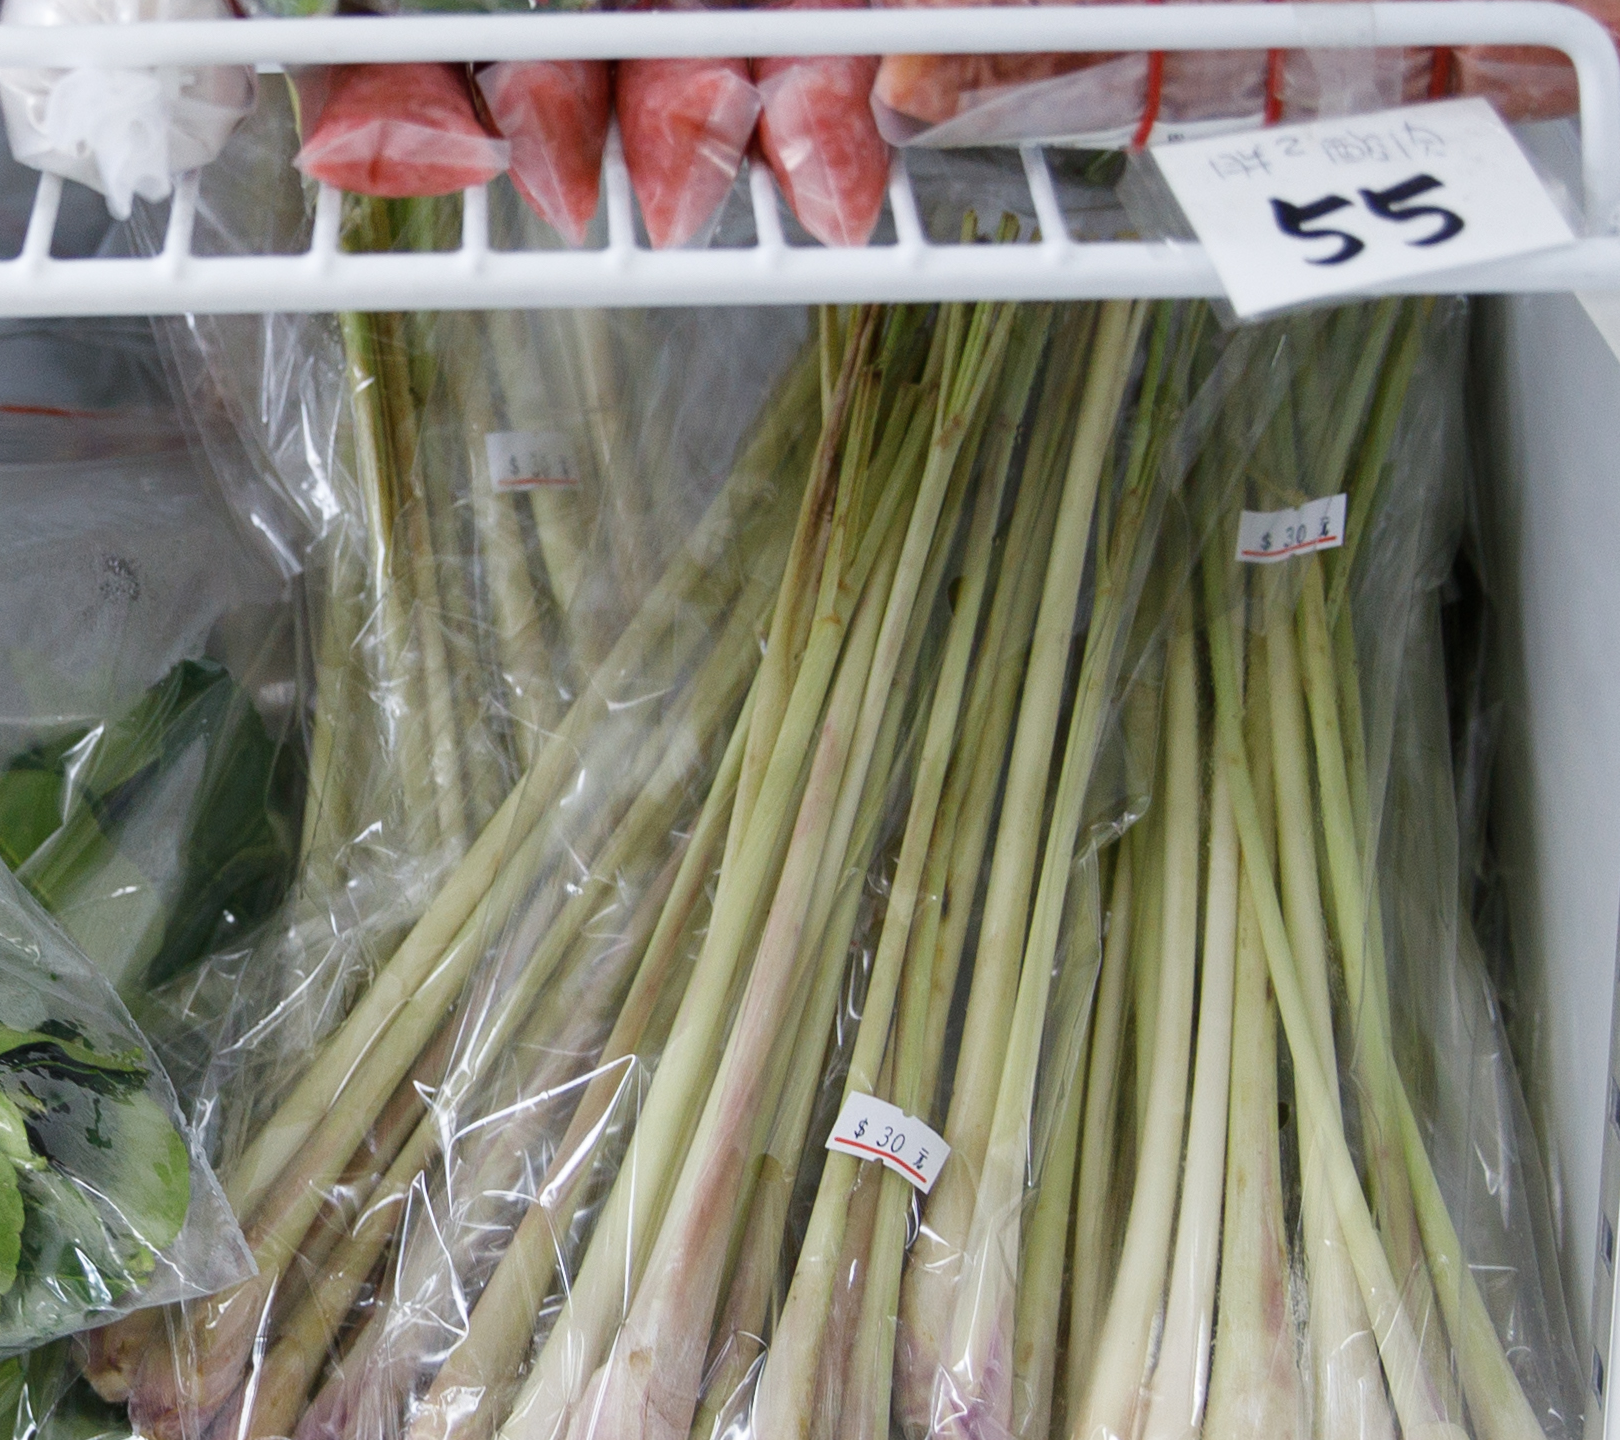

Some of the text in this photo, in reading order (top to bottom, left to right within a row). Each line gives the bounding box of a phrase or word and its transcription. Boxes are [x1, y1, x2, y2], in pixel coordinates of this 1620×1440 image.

[1270, 174, 1465, 266] 55
[853, 1117, 870, 1140] $
[875, 1125, 907, 1153] 30
